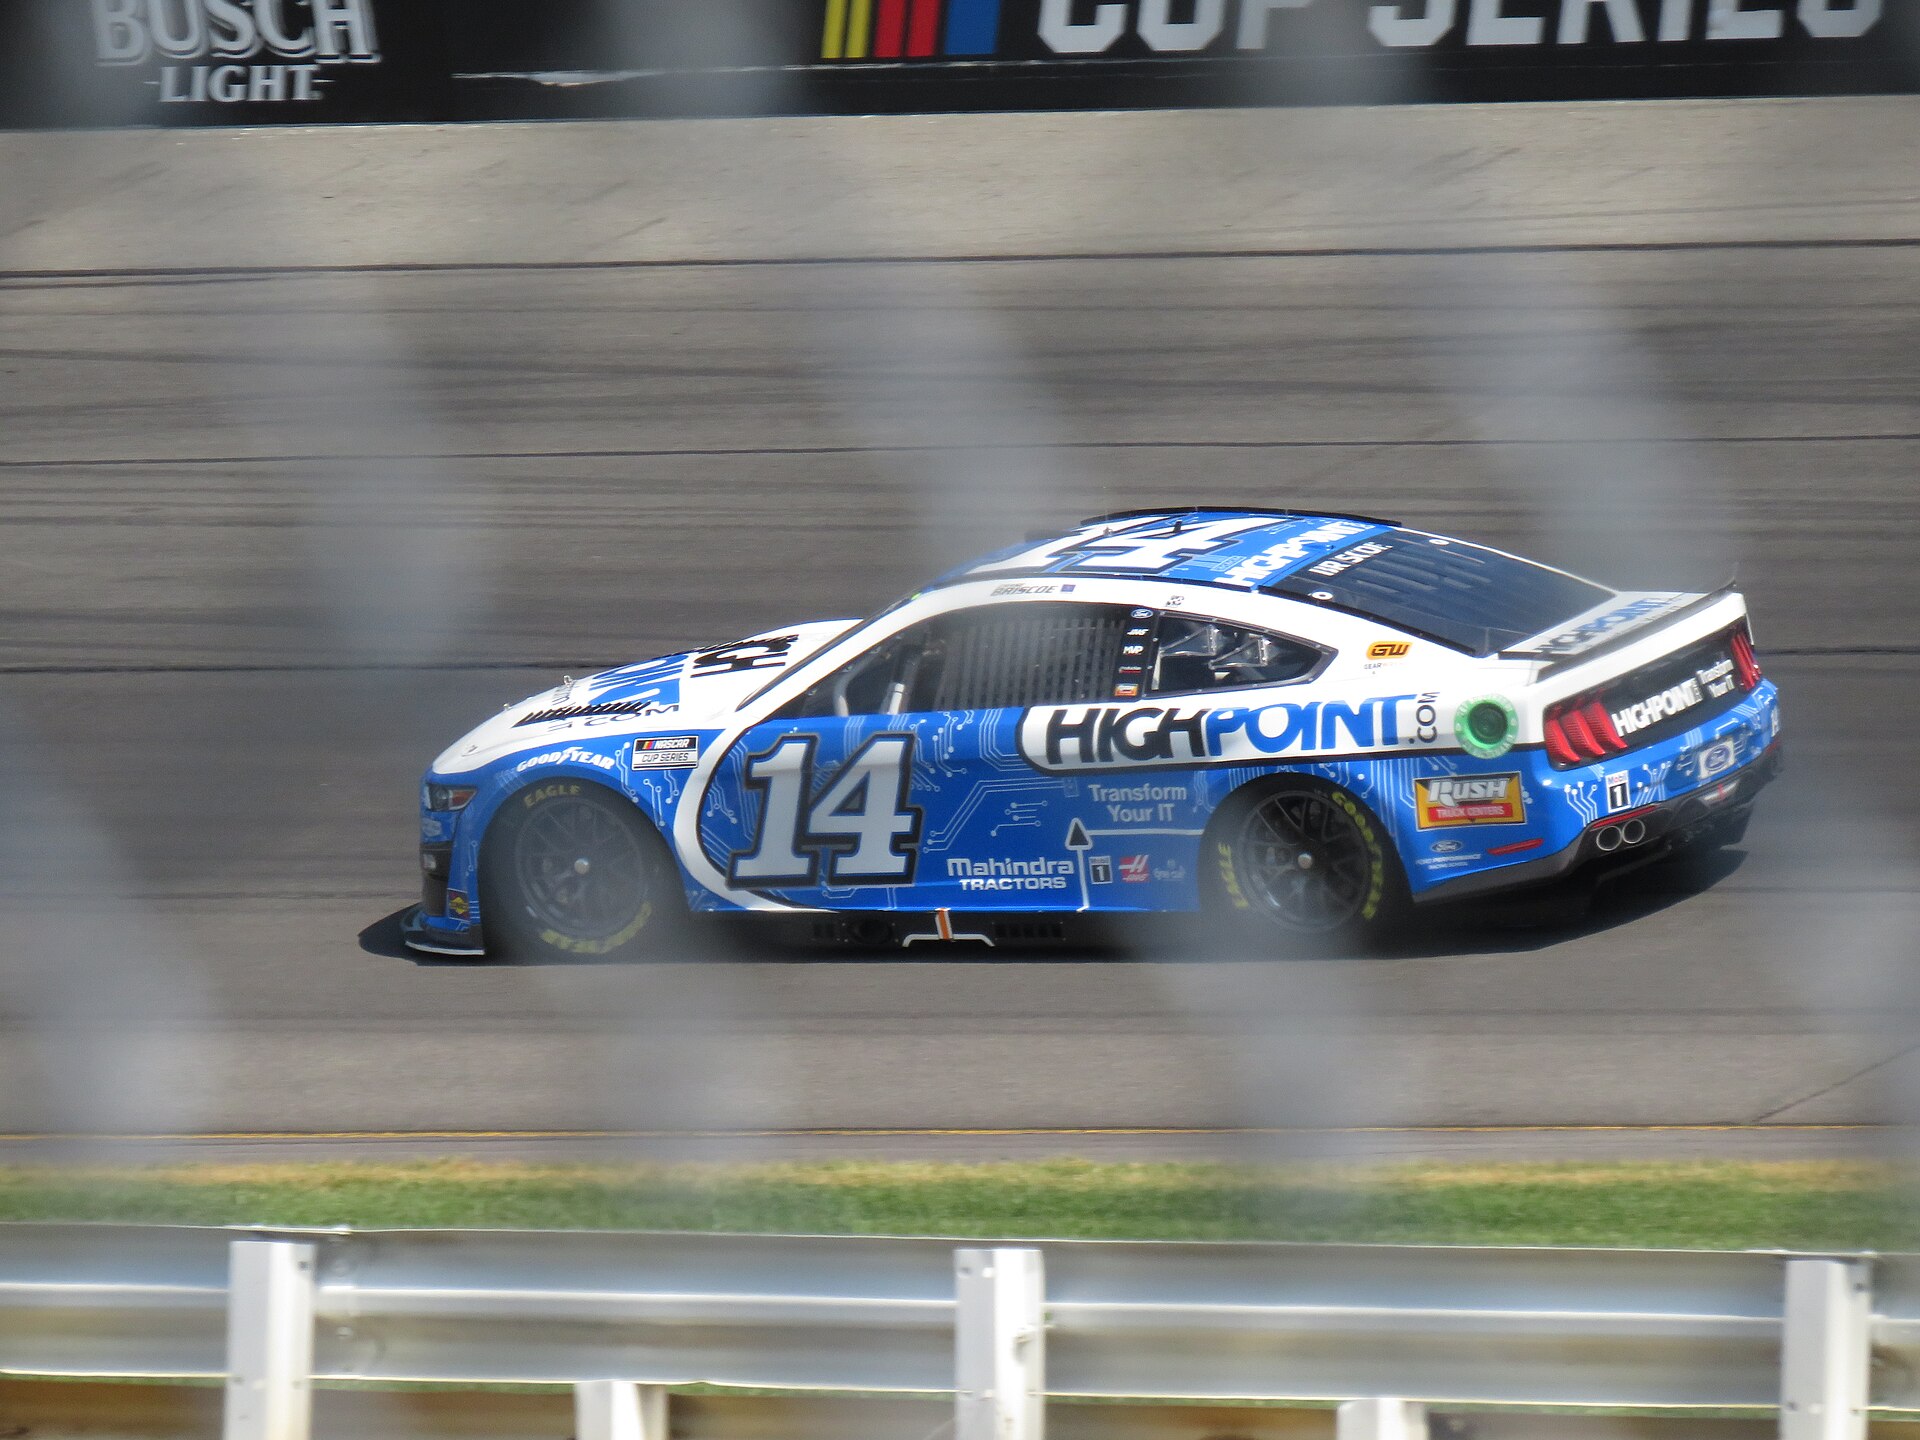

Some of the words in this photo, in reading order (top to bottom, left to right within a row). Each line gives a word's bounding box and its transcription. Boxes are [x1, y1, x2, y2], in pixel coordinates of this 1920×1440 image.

[97, 0, 382, 64] BUSCH
[160, 65, 324, 102] LIGHT
[990, 585, 1058, 597] BRISCOE
[1123, 645, 1144, 655] MVP
[1371, 644, 1409, 656] GW
[1611, 677, 1697, 737] HIGHPOINT
[1045, 695, 1418, 765] HIGHPOINT
[654, 738, 690, 749] NASCAR
[517, 746, 615, 772] GOODYEAR
[641, 753, 658, 763] CUP
[660, 752, 690, 763] SERIES
[524, 785, 581, 807] EAGLE
[1088, 783, 1187, 802] Transform
[1429, 779, 1509, 807] RUSH
[1612, 785, 1623, 807] 1
[727, 734, 923, 887] 14
[1106, 804, 1153, 822] Your
[1158, 803, 1175, 822] IT
[1436, 807, 1465, 818] TRUCK
[1467, 806, 1505, 817] CENTERS
[947, 857, 1075, 876] Mahindra
[1096, 865, 1105, 882] 1
[959, 877, 1067, 891] TRACTORS
